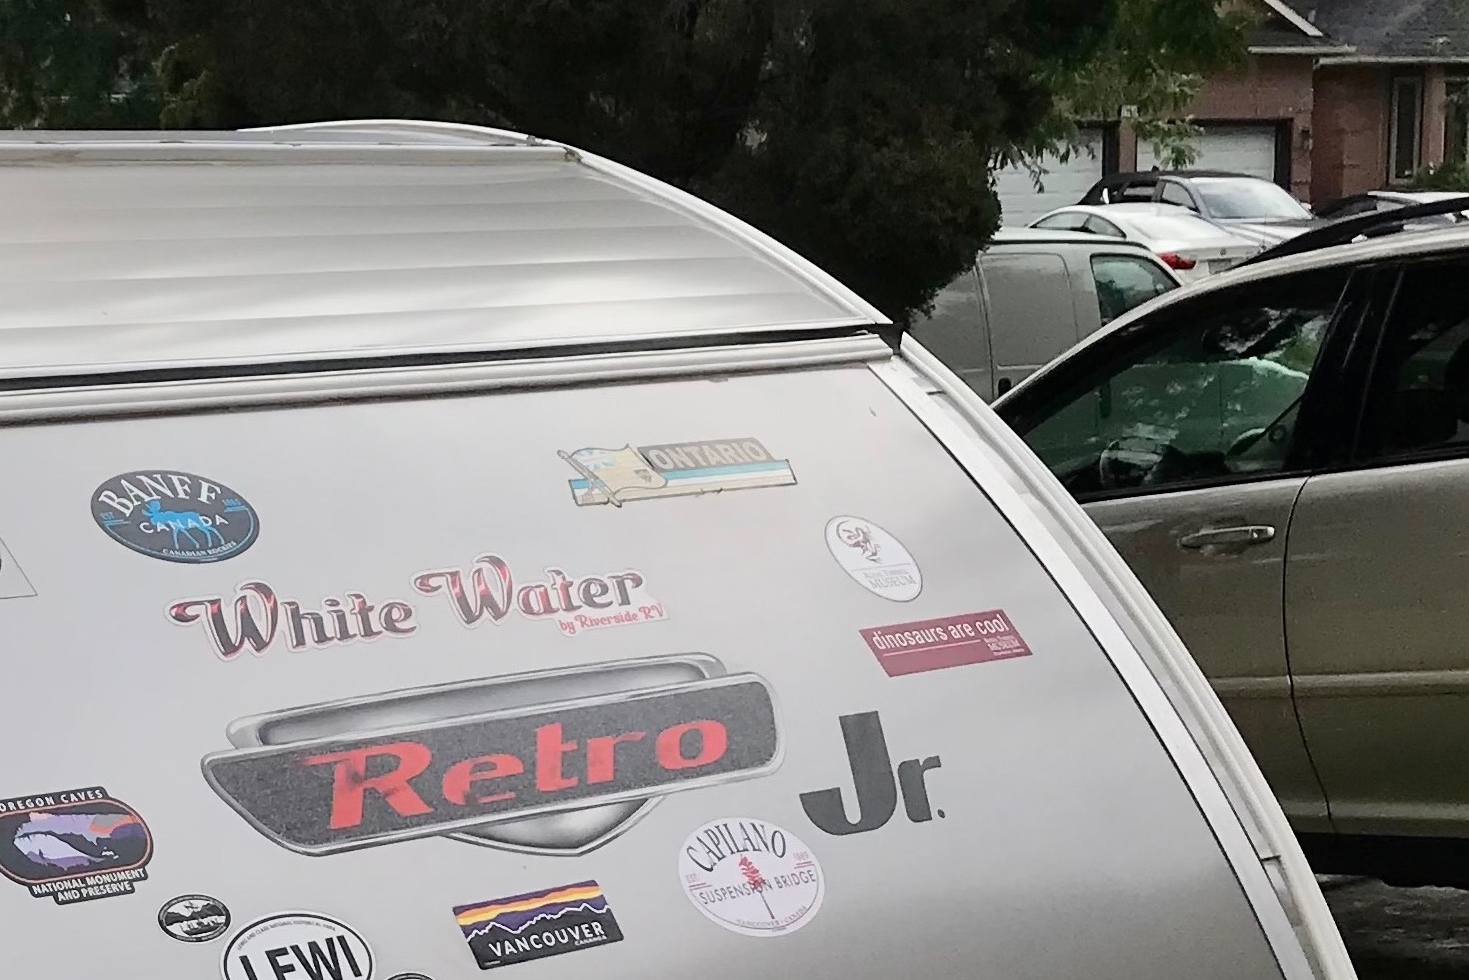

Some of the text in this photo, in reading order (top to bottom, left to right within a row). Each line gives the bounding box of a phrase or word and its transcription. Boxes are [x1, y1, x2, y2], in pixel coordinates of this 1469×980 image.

[649, 441, 767, 469] ONTARIO
[98, 474, 222, 517] BANFF
[139, 515, 229, 533] CANADA
[162, 549, 206, 558] CANADIAN
[170, 555, 644, 658] White Water
[558, 603, 663, 634] by Riverside RV
[872, 613, 1010, 650] dinosaurs are cool
[294, 710, 946, 836] Retro Jr.
[60, 789, 103, 804] CAVES
[686, 822, 786, 872] CAPILANO
[32, 868, 145, 895] NATIONAL MONUMENT
[58, 881, 132, 902] AND PRESERVE
[774, 870, 816, 889] BRIDGE
[488, 921, 605, 957] VANCOUVER
